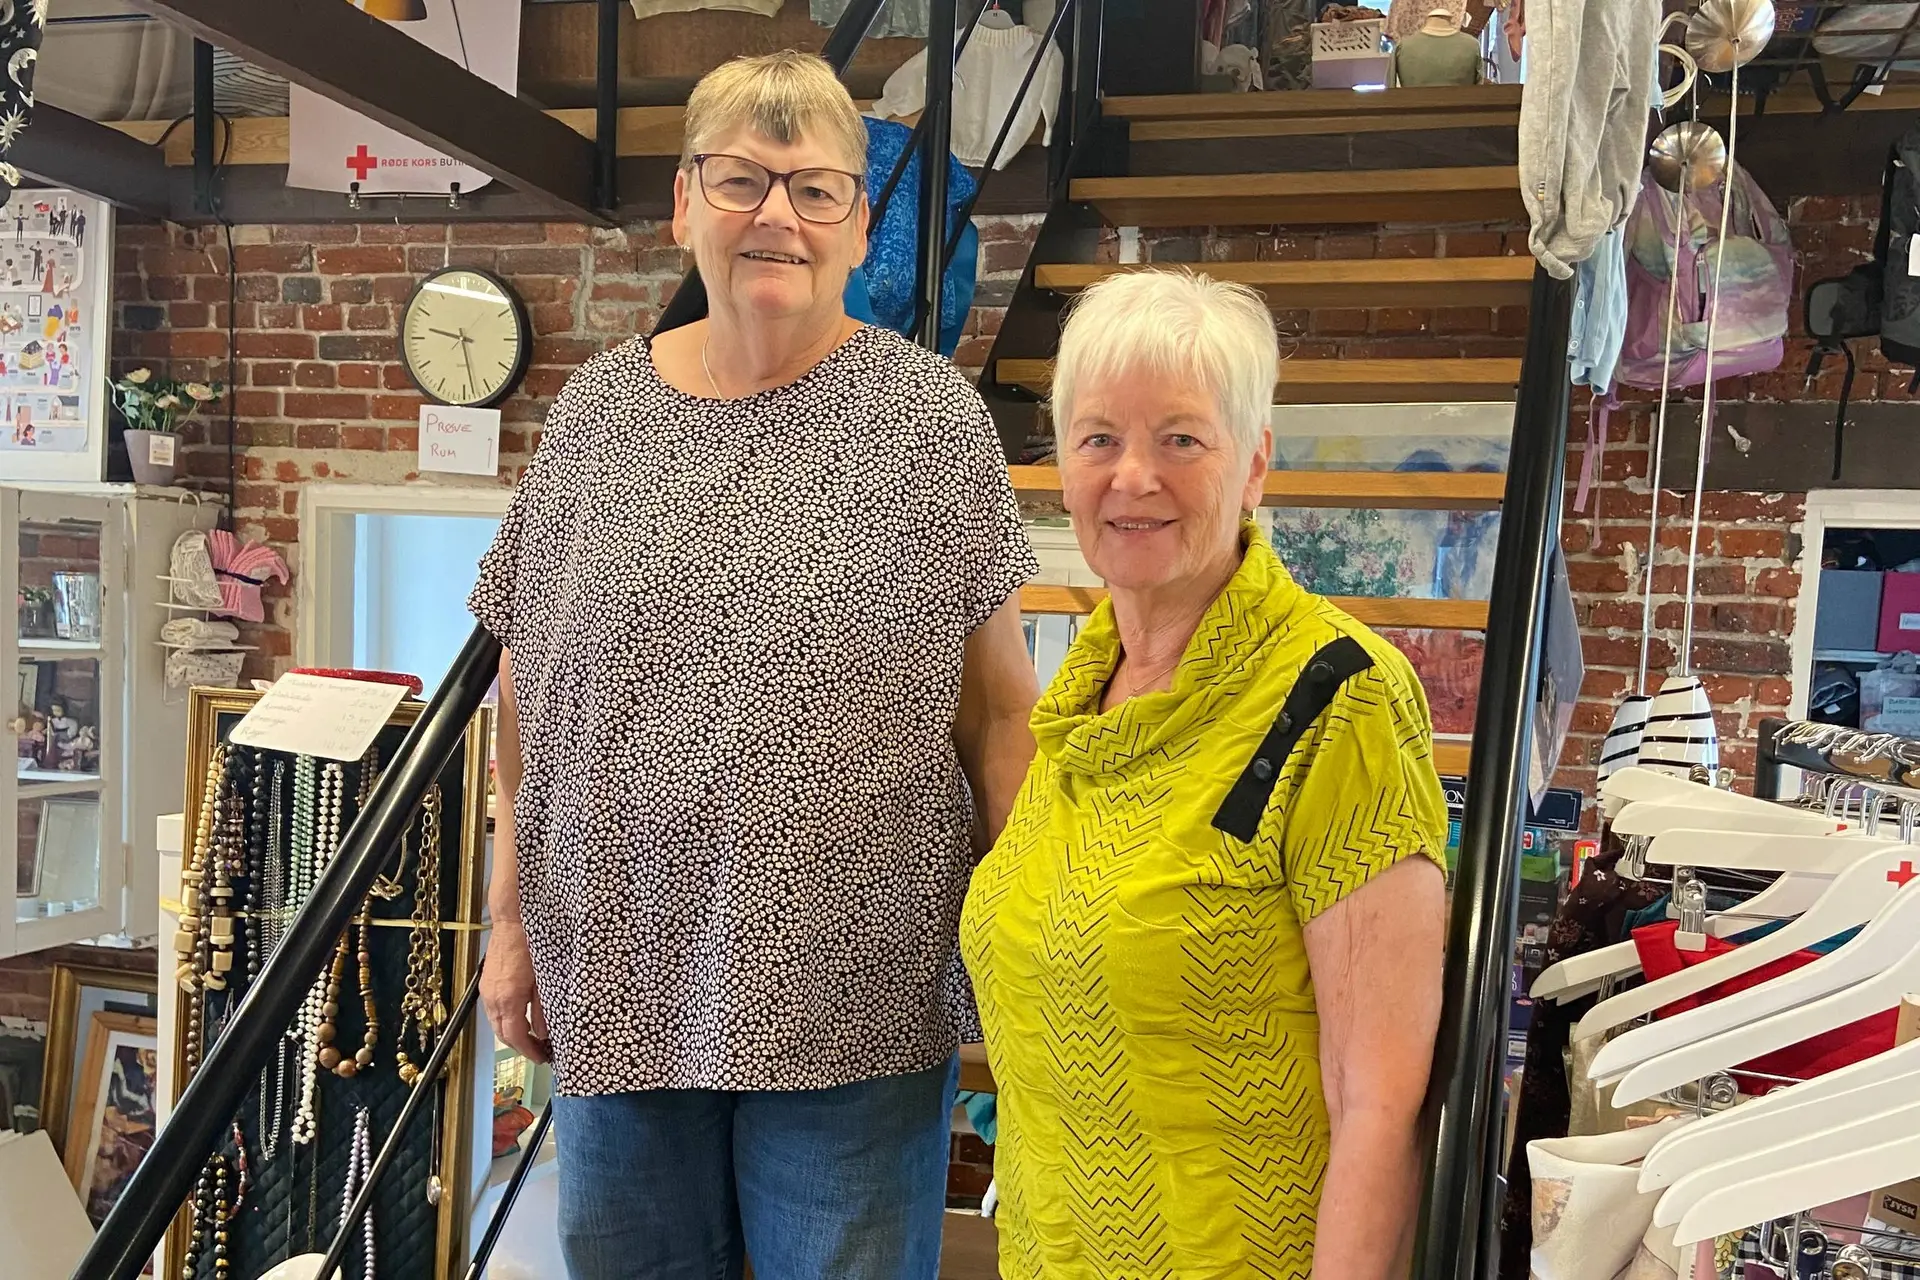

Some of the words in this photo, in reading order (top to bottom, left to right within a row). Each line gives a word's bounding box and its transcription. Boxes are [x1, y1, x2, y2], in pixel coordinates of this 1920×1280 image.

[381, 158, 408, 167] RØDE
[411, 158, 437, 167] KORS
[1889, 1201, 1915, 1216] JYSK
